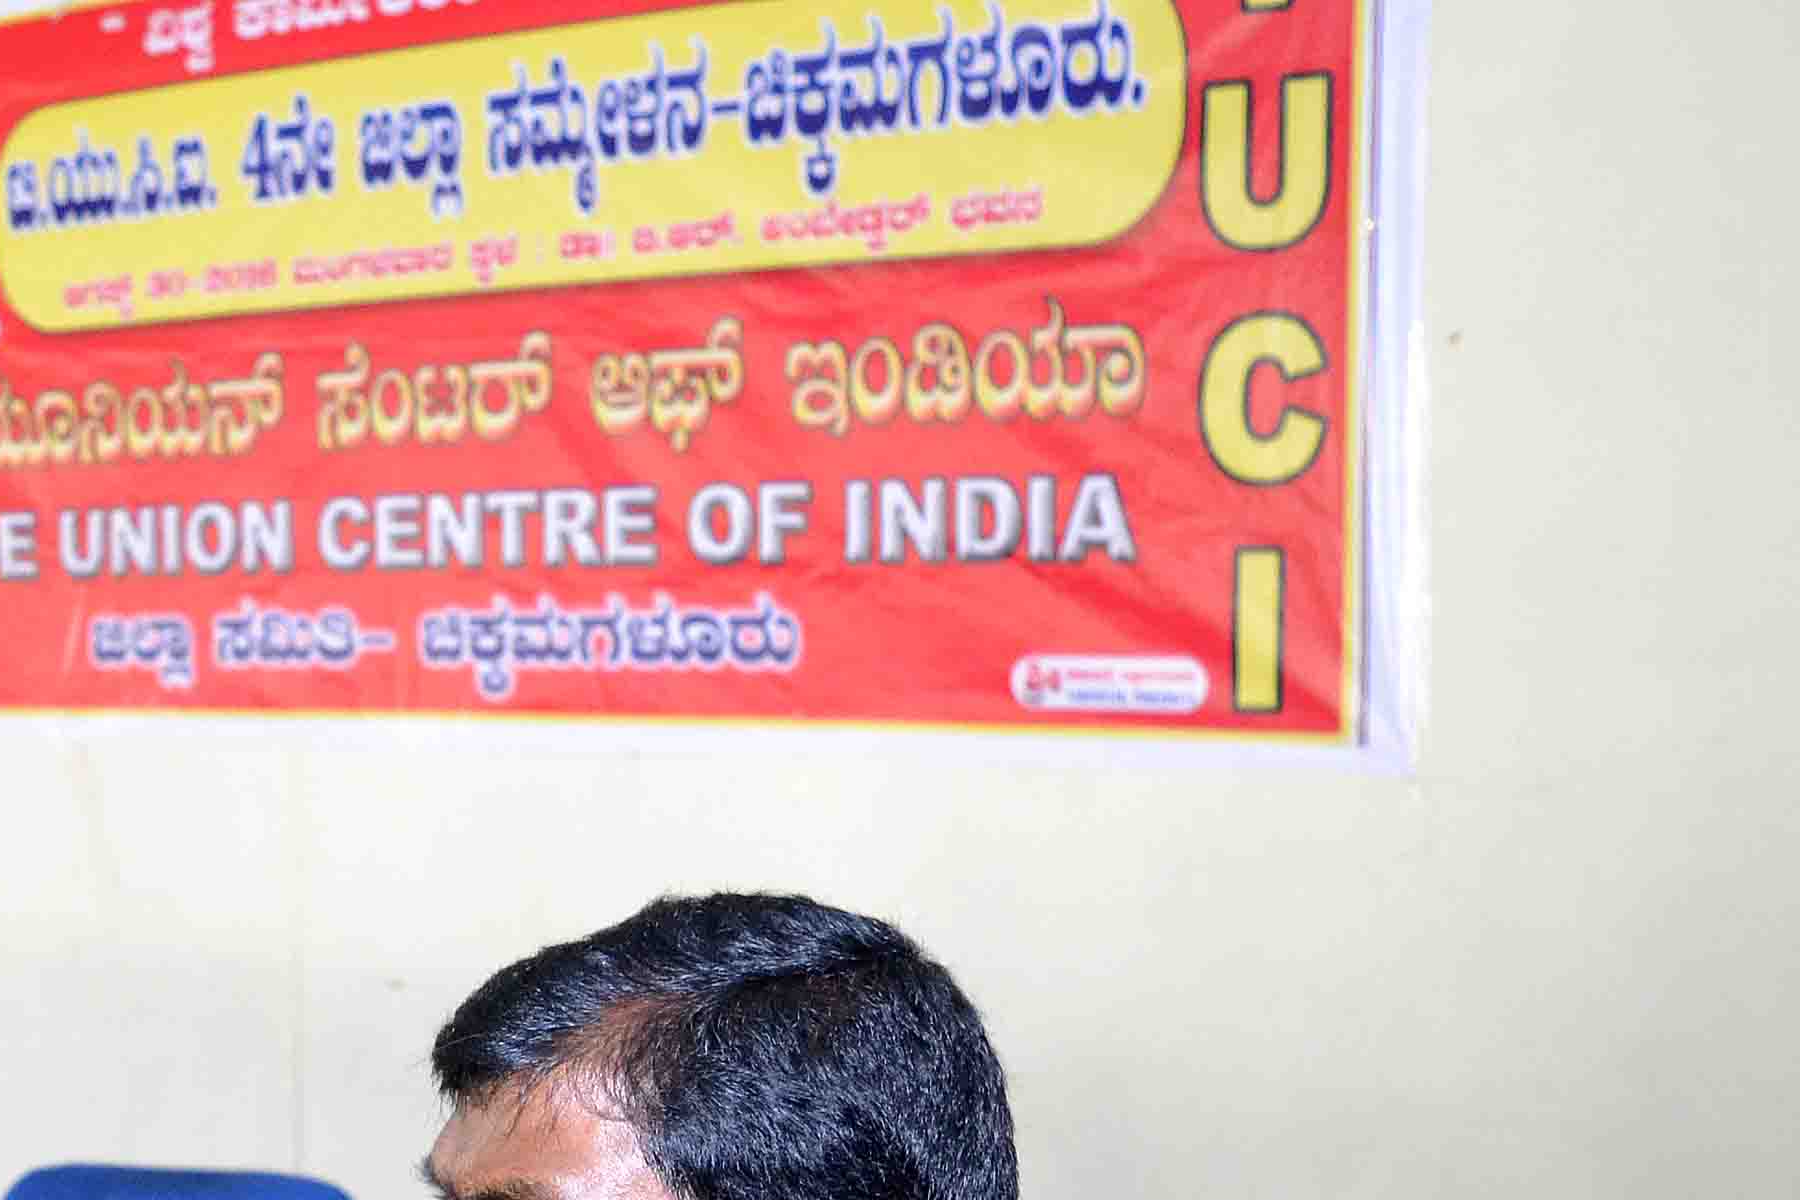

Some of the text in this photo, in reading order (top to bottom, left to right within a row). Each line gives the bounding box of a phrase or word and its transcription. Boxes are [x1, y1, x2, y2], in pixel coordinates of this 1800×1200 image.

[242, 95, 334, 199] 4ನೇ
[361, 104, 462, 216] ಜಿಲ್ಲಾ
[315, 329, 552, 452] ಸೆಂಟರ್
[785, 294, 1145, 437] ಇಂಡಿಯಾ
[1200, 0, 1332, 714] UCI
[59, 500, 292, 578] UNION
[318, 486, 657, 571] CENTRE
[687, 480, 810, 567] OF
[844, 473, 1137, 565] INDIA
[91, 615, 192, 687] ಜಿಲ್ಲಾ
[421, 593, 800, 695] ಚಿಕ್ಕಮಗಳೂರು
